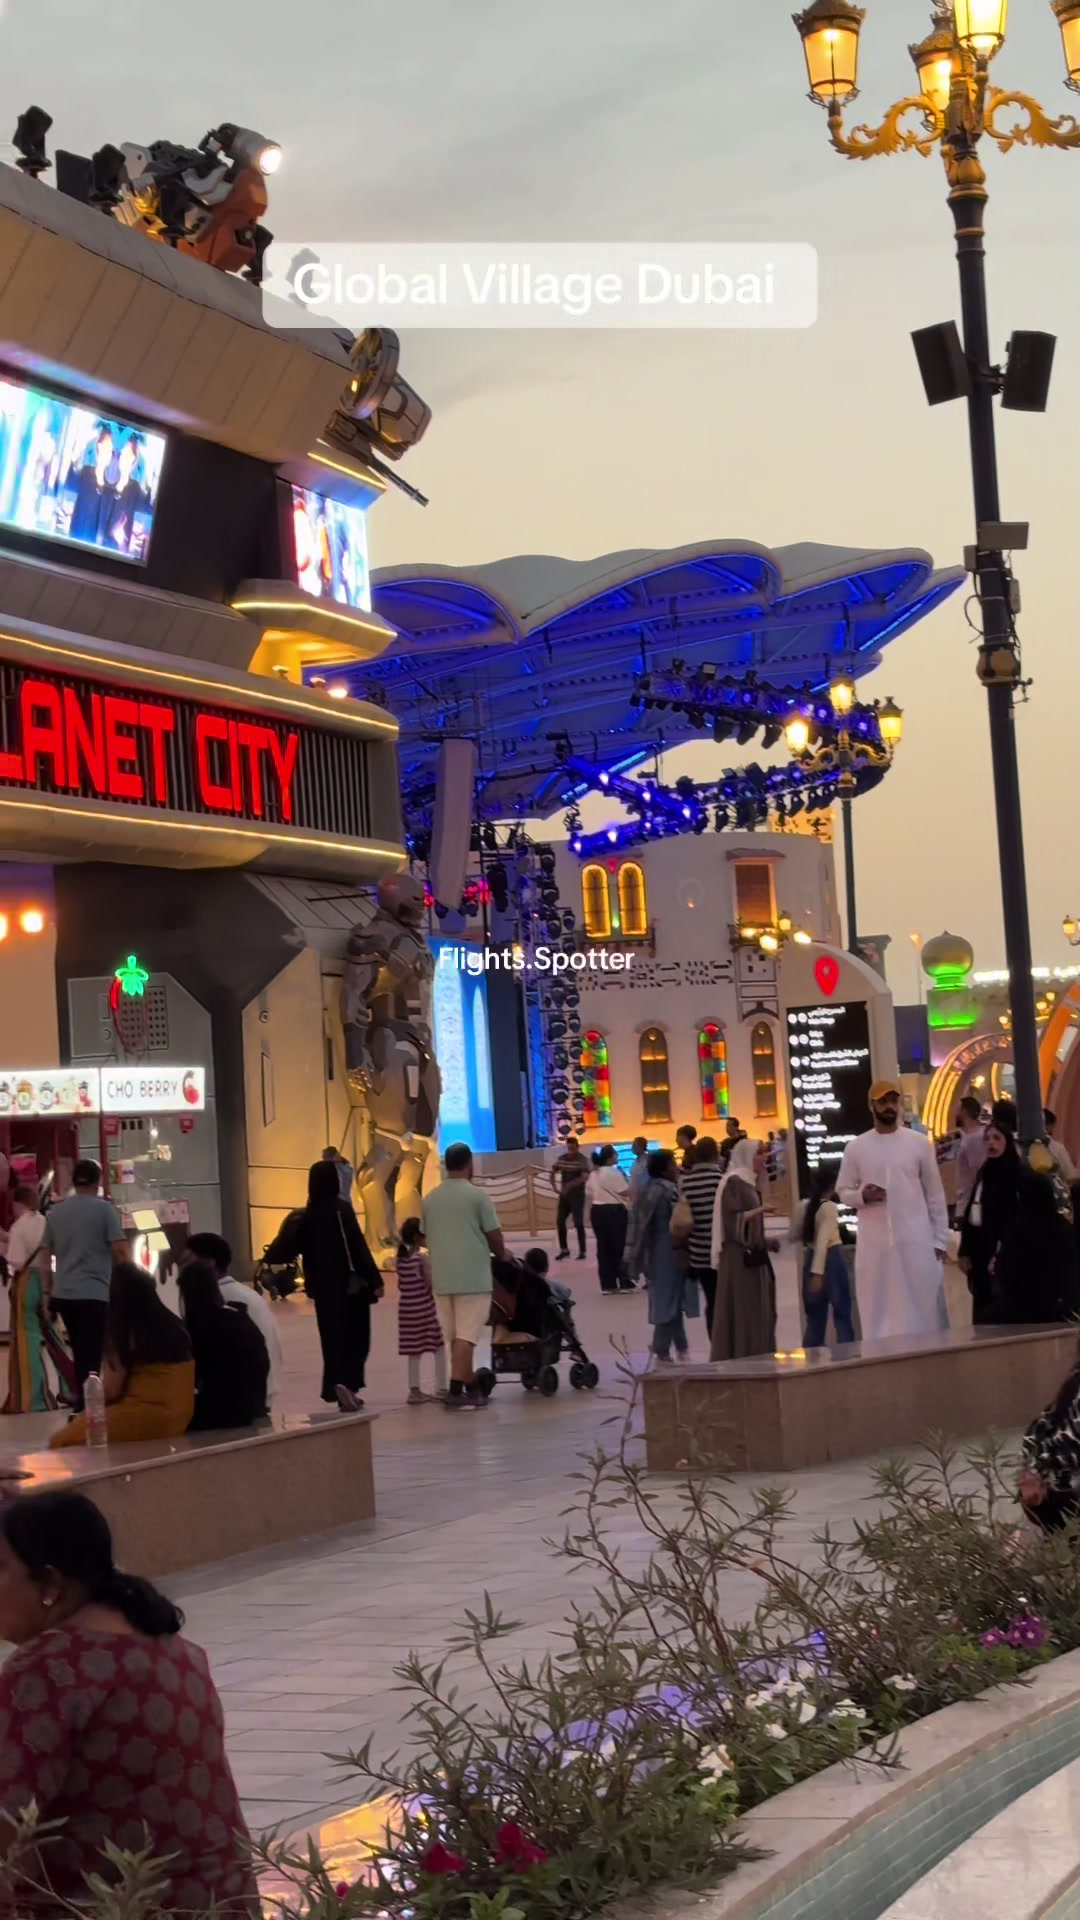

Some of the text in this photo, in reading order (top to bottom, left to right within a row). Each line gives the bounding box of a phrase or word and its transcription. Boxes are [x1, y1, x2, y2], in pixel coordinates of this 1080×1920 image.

[196, 714, 298, 821] CITY
[107, 1080, 178, 1099] CHO BERRY
